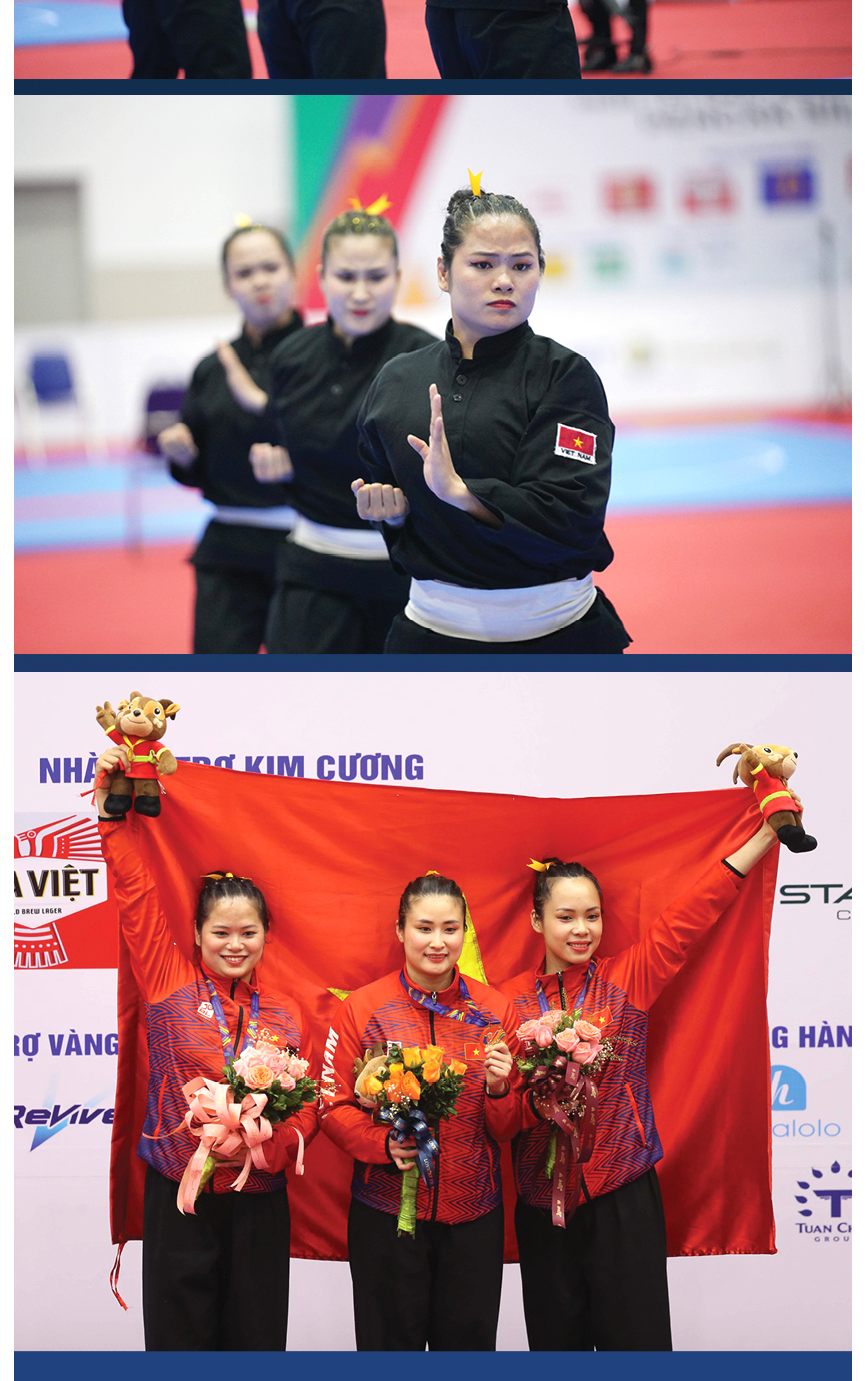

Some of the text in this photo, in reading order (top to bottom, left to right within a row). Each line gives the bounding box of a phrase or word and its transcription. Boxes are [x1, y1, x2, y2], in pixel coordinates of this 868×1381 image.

[245, 755, 305, 778] KIM
[316, 752, 424, 781] CƯƠNG
[26, 863, 100, 902] VIỆT
[41, 907, 63, 915] LAGER
[48, 1028, 118, 1056] VÀNG
[799, 1020, 852, 1048] HÀN
[796, 1222, 832, 1233] TUAN
